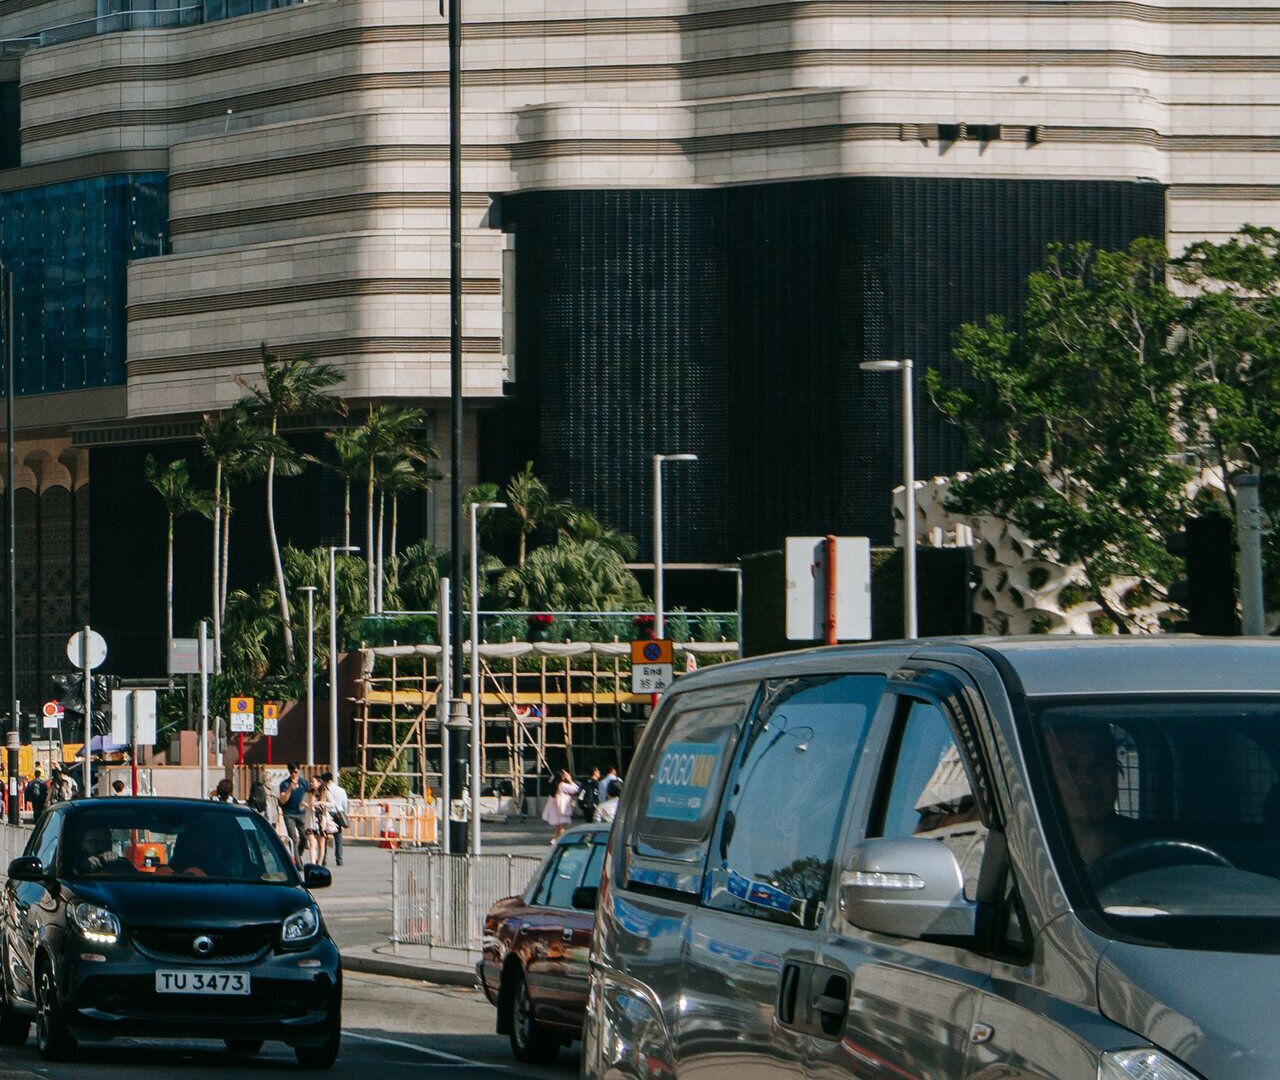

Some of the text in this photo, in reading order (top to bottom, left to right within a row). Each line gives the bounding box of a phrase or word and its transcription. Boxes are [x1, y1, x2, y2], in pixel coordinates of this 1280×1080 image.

[643, 666, 662, 676] End
[161, 973, 244, 991] TU 3473
